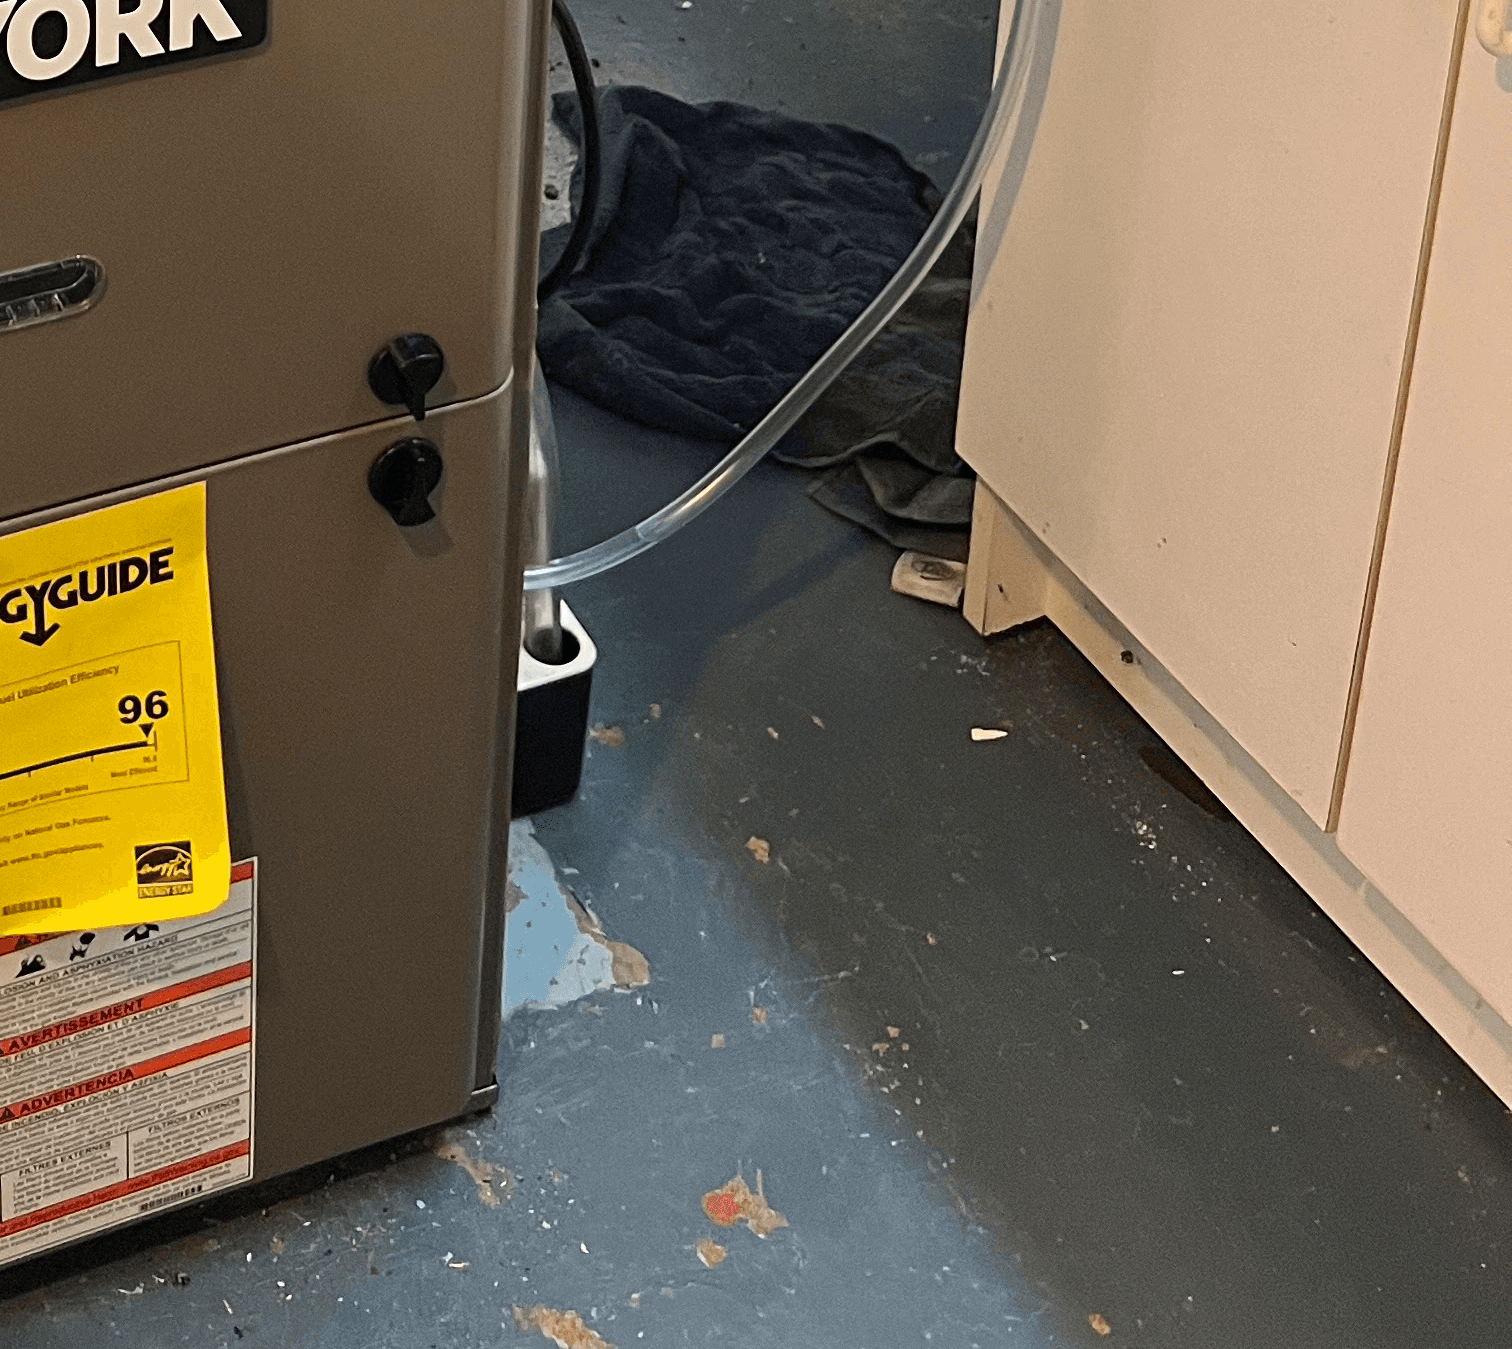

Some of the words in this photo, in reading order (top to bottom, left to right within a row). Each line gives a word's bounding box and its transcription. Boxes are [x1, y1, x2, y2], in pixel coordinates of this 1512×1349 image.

[17, 677, 69, 699] Utilization
[70, 664, 120, 685] Efficiency
[117, 689, 169, 725] 96
[172, 884, 193, 896] STAR
[8, 997, 144, 1052] AVERTISSEMENT
[19, 1066, 134, 1115] ADVERTENCIA
